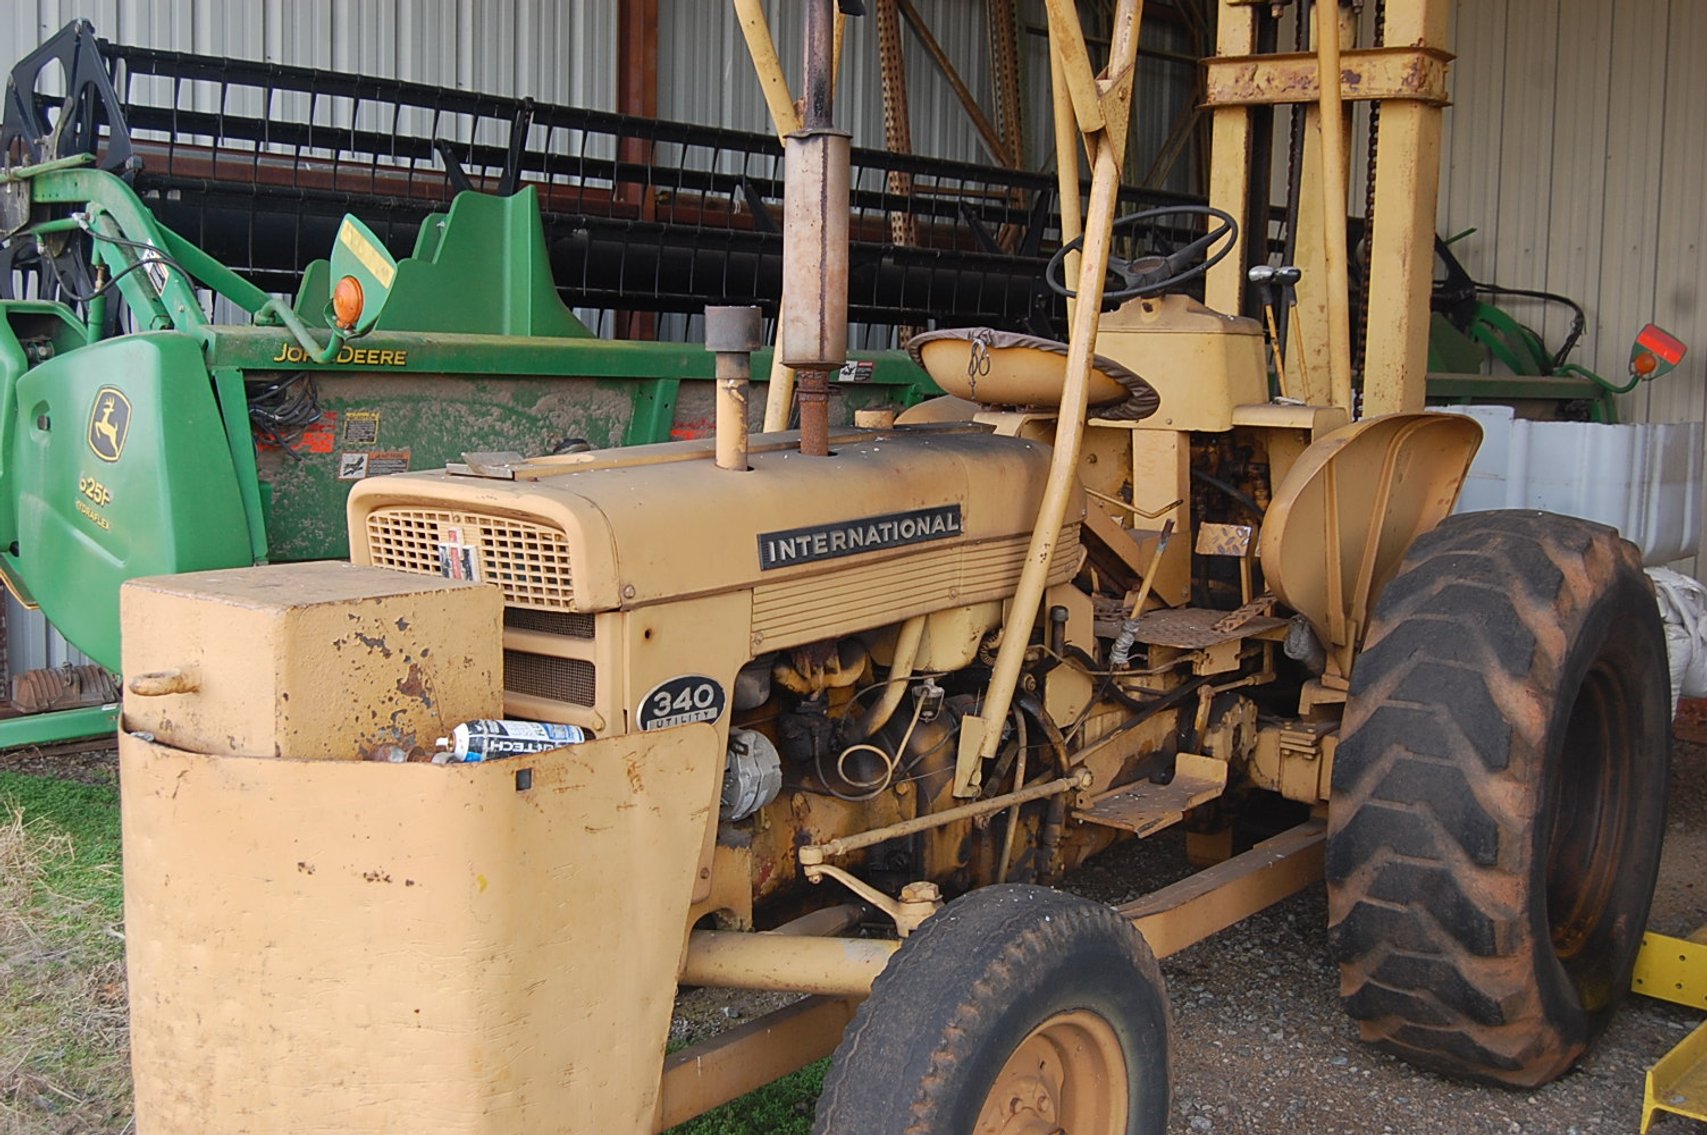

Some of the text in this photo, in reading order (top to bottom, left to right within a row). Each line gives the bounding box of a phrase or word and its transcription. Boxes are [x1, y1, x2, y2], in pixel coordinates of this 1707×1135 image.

[273, 343, 407, 366] JO DEERE
[767, 512, 959, 563] INTERNATIONAL
[653, 683, 715, 717] 340
[656, 710, 710, 728] UTILITY
